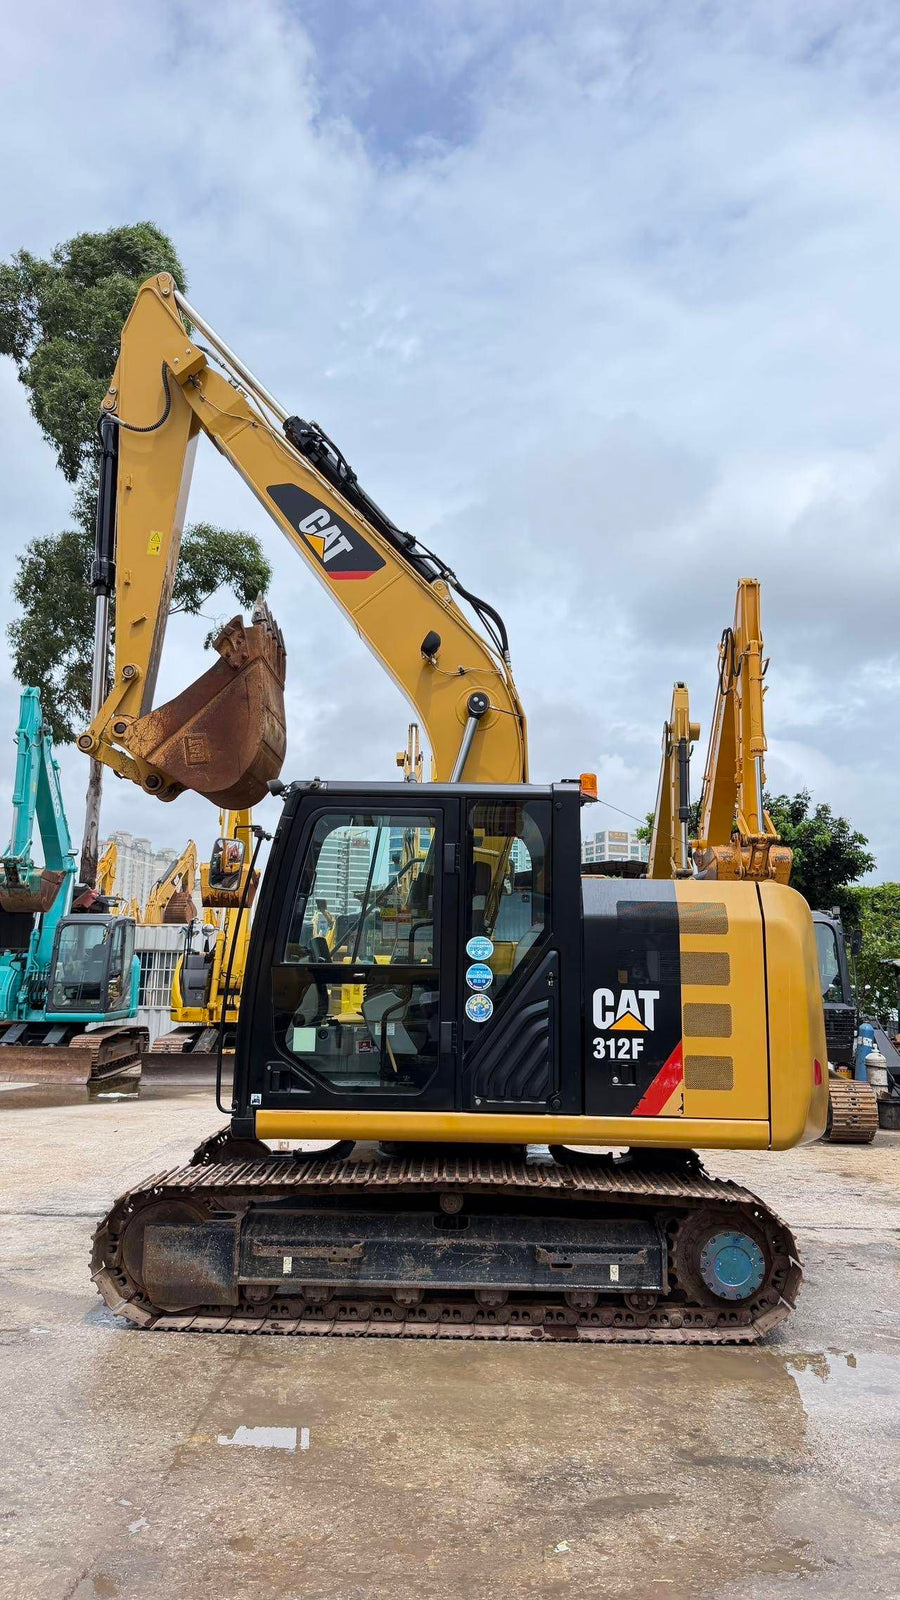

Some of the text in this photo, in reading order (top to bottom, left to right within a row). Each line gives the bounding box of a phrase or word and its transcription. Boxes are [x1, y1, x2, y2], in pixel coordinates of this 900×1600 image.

[298, 508, 354, 563] CAT
[592, 988, 660, 1031] CAT
[592, 1037, 644, 1059] 312F
